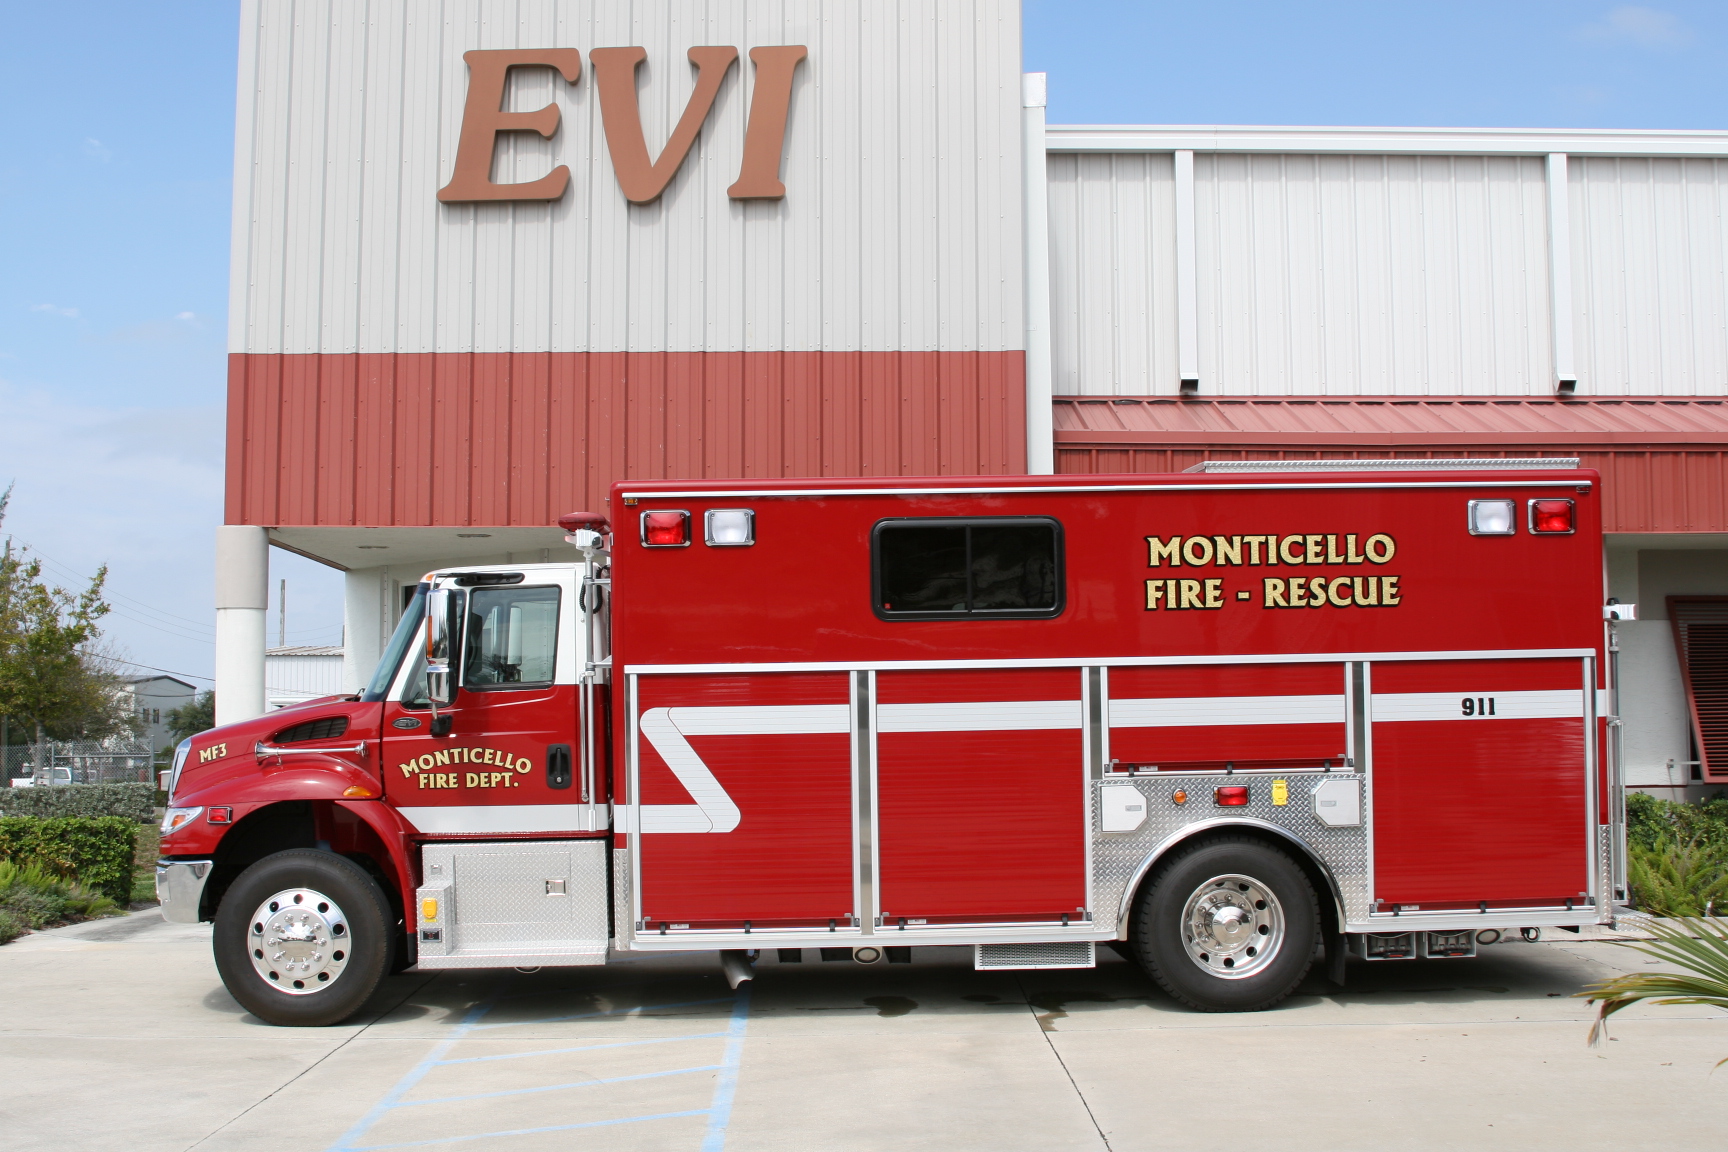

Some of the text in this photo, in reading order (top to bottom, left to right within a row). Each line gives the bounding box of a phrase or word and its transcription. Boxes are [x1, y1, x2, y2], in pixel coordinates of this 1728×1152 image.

[436, 45, 808, 205] EVI
[1145, 533, 1397, 567] MONTICELLO
[1145, 577, 1225, 610] FIRE
[1263, 575, 1402, 608] RESCUE
[1461, 697, 1496, 716] 911
[198, 742, 227, 764] MF3
[398, 747, 533, 779] MONTICELLO
[418, 771, 519, 789] FIRE DEPT.
